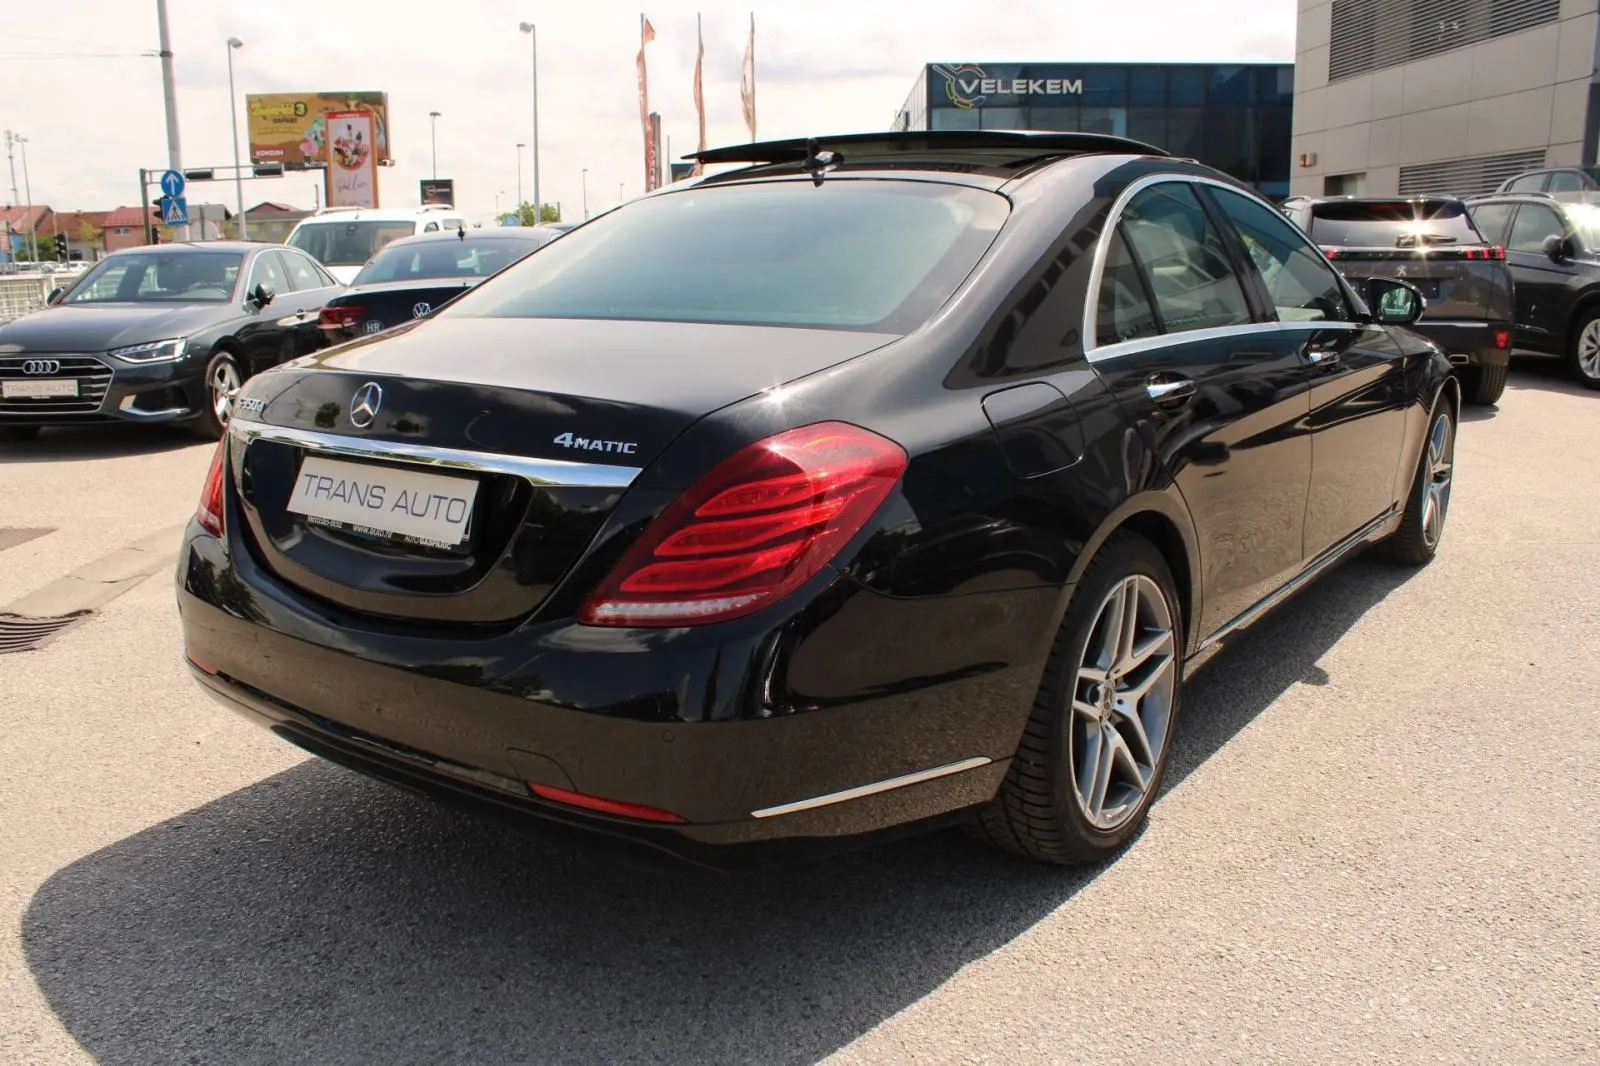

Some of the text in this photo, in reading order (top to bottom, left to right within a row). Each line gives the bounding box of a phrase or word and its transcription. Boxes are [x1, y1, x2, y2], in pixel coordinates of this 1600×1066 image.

[958, 79, 1082, 94] VELEKEM
[366, 322, 381, 333] HR
[553, 432, 637, 454] 4MATIC
[304, 473, 467, 524] TRANS AUTO
